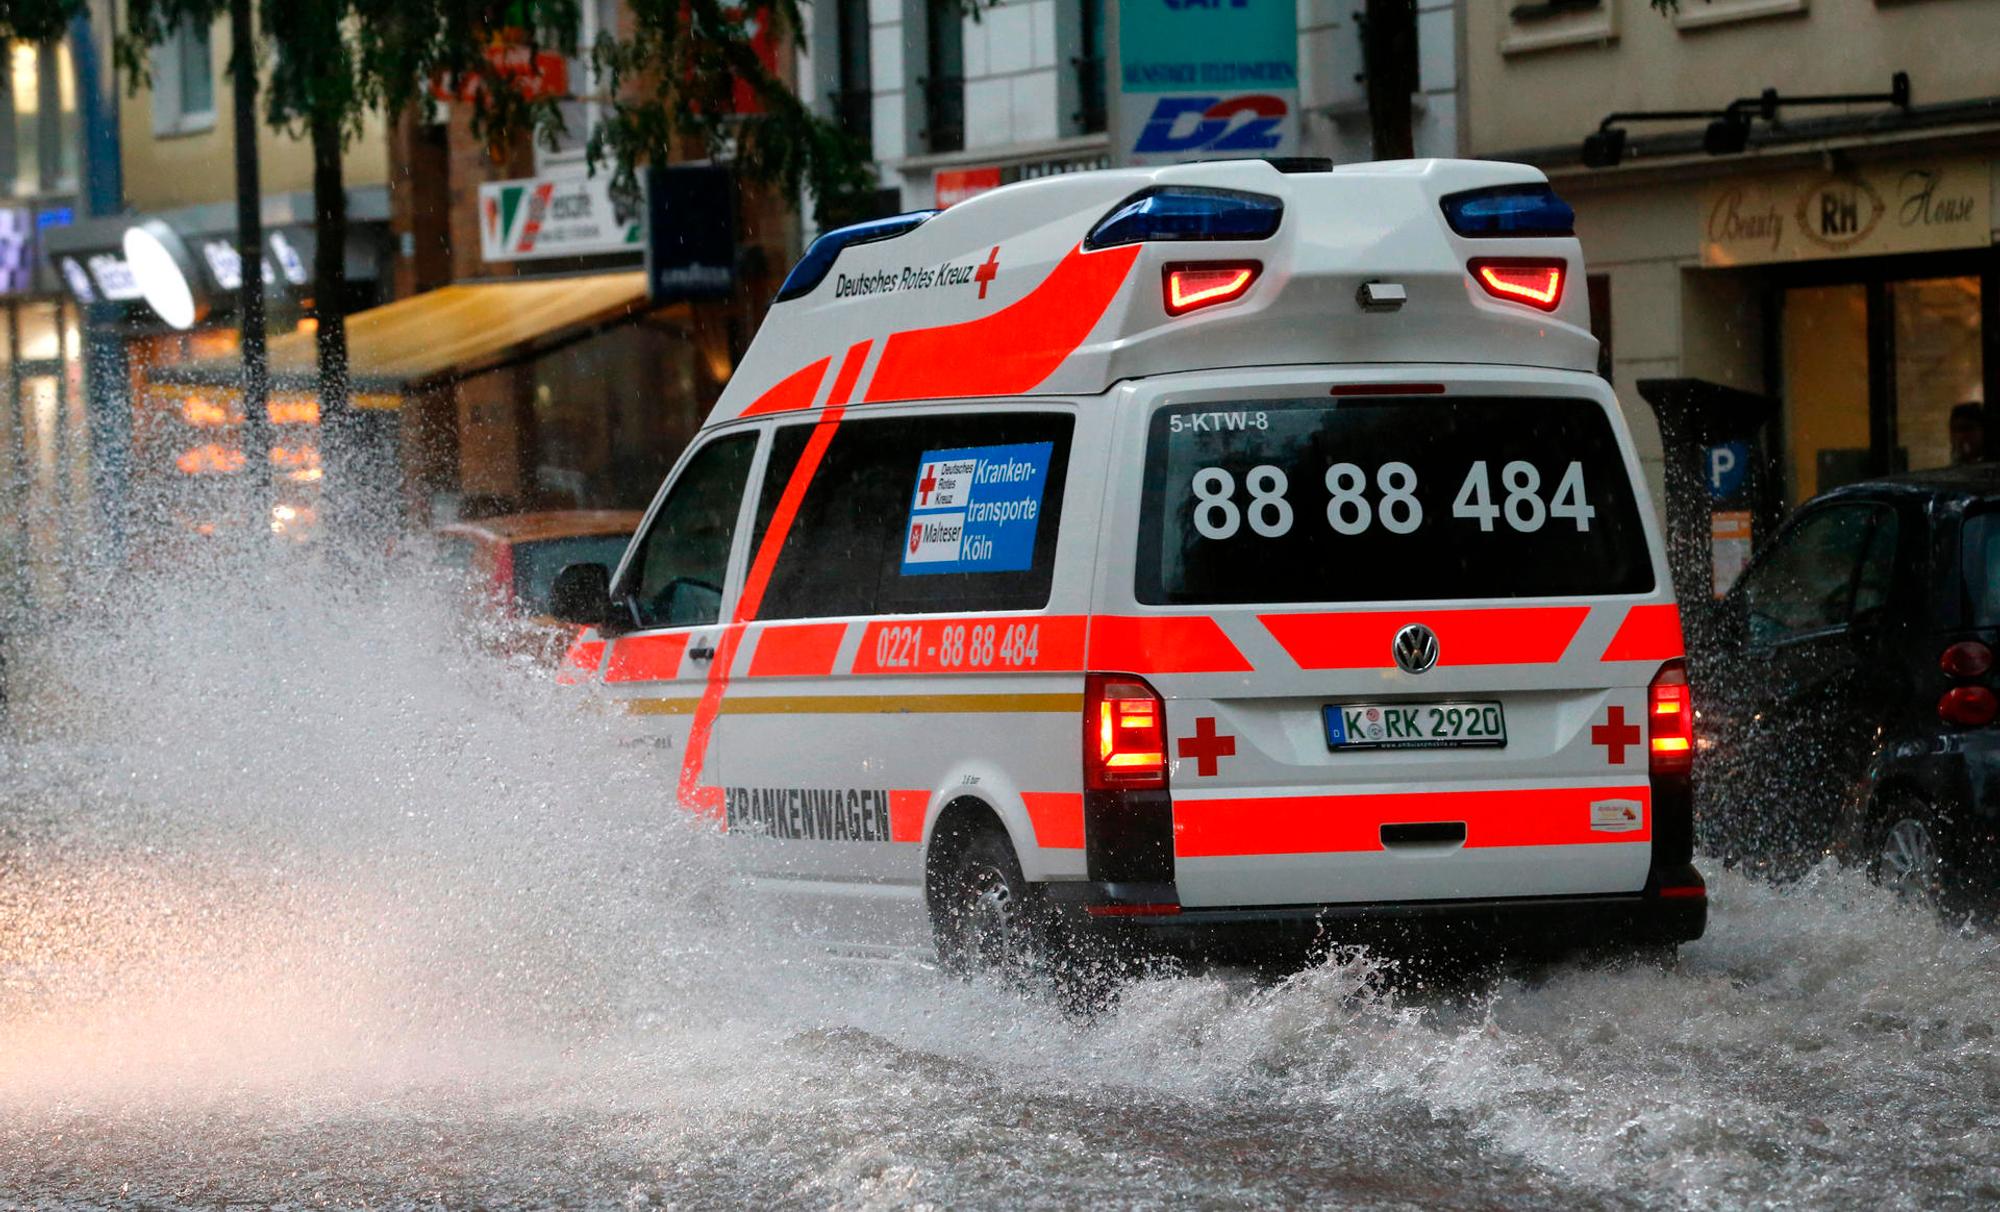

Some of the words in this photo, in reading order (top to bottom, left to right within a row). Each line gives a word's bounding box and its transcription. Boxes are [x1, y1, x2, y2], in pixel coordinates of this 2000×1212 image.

[1133, 94, 1288, 152] D2
[1708, 190, 1784, 251] Beauty
[1820, 192, 1858, 235] RH
[1898, 169, 1974, 229] House
[835, 269, 898, 298] Deutsches
[898, 267, 935, 290] Rotes
[935, 262, 974, 287] Kreuz
[1169, 411, 1269, 432] 5-KTW-8
[938, 478, 957, 490] Rotes
[941, 462, 974, 476] Deutsches
[974, 457, 1036, 485] Kranken-
[1711, 448, 1736, 488] P
[935, 492, 953, 505] Kreuz
[967, 495, 1037, 527] transporte
[1191, 464, 1294, 540] 88
[1324, 461, 1423, 536] 88
[1452, 460, 1596, 532] 484
[923, 521, 962, 543] Malteser
[961, 534, 993, 560] Köln
[876, 626, 923, 667] 0221
[939, 625, 965, 667] 88
[969, 624, 995, 666] 88
[1000, 623, 1039, 666] 484
[1345, 711, 1366, 739] K
[1384, 708, 1423, 738] RK
[1429, 707, 1500, 737] 2920
[726, 787, 890, 842] KRANKENWAGEN
